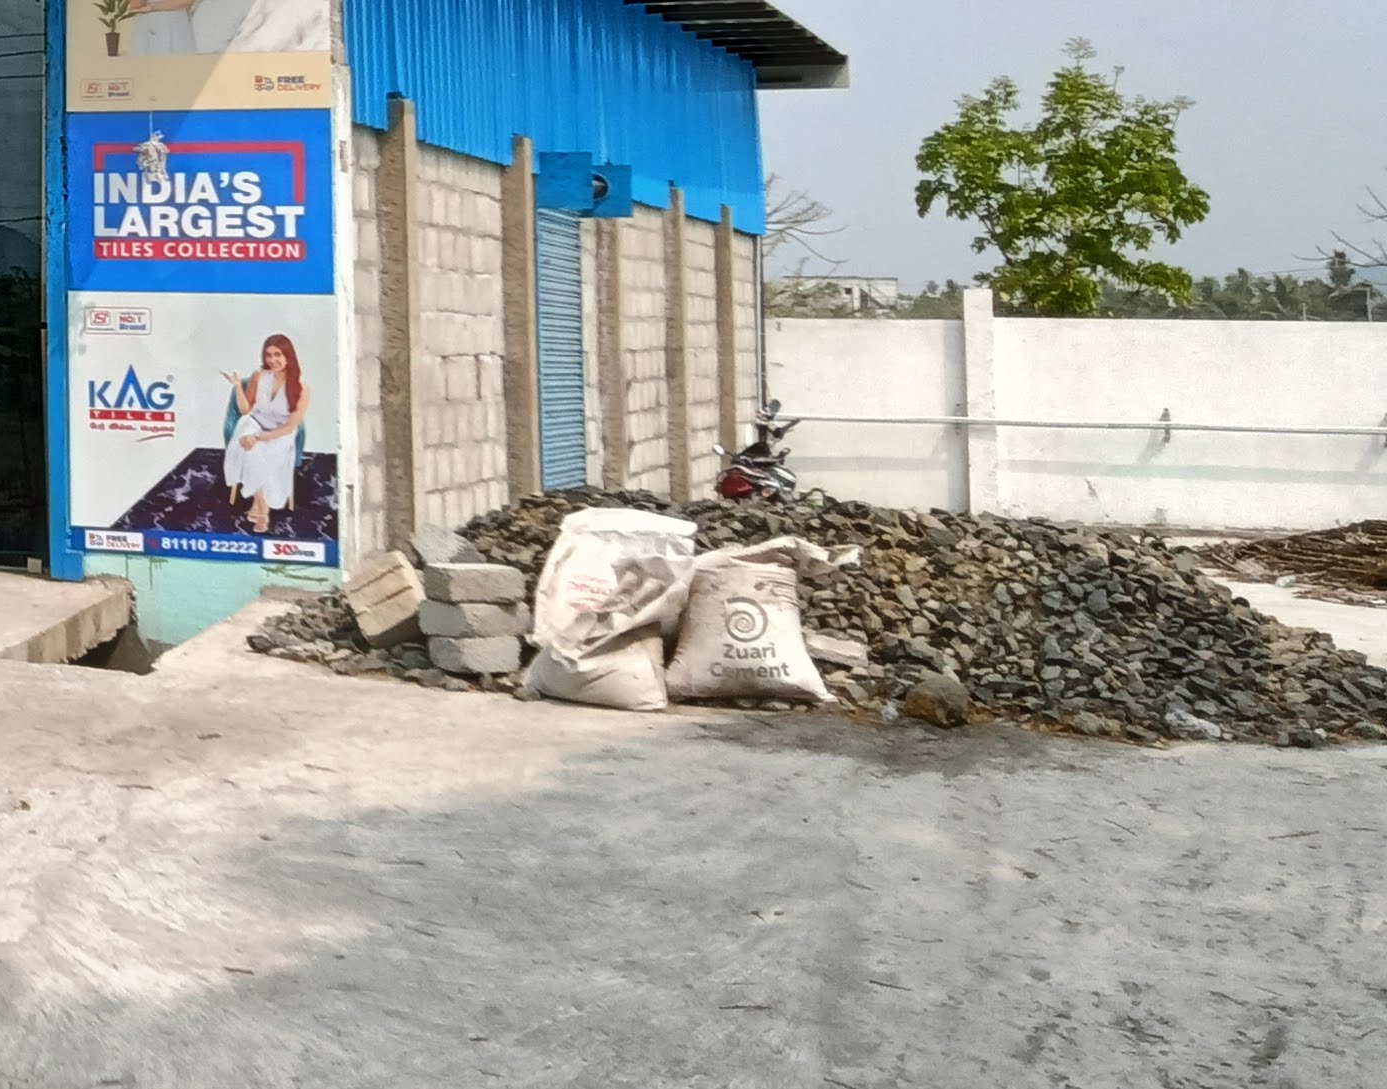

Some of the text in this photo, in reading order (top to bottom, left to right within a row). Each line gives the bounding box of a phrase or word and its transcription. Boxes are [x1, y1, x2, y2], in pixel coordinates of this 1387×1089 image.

[93, 171, 262, 204] INDIA'S
[94, 205, 305, 238] LARGEST
[99, 241, 301, 259] TILES COLLECTION
[88, 364, 175, 410] KAG
[161, 537, 258, 555] 81110 22222
[723, 642, 776, 659] Zuari
[709, 662, 791, 678] Cement
